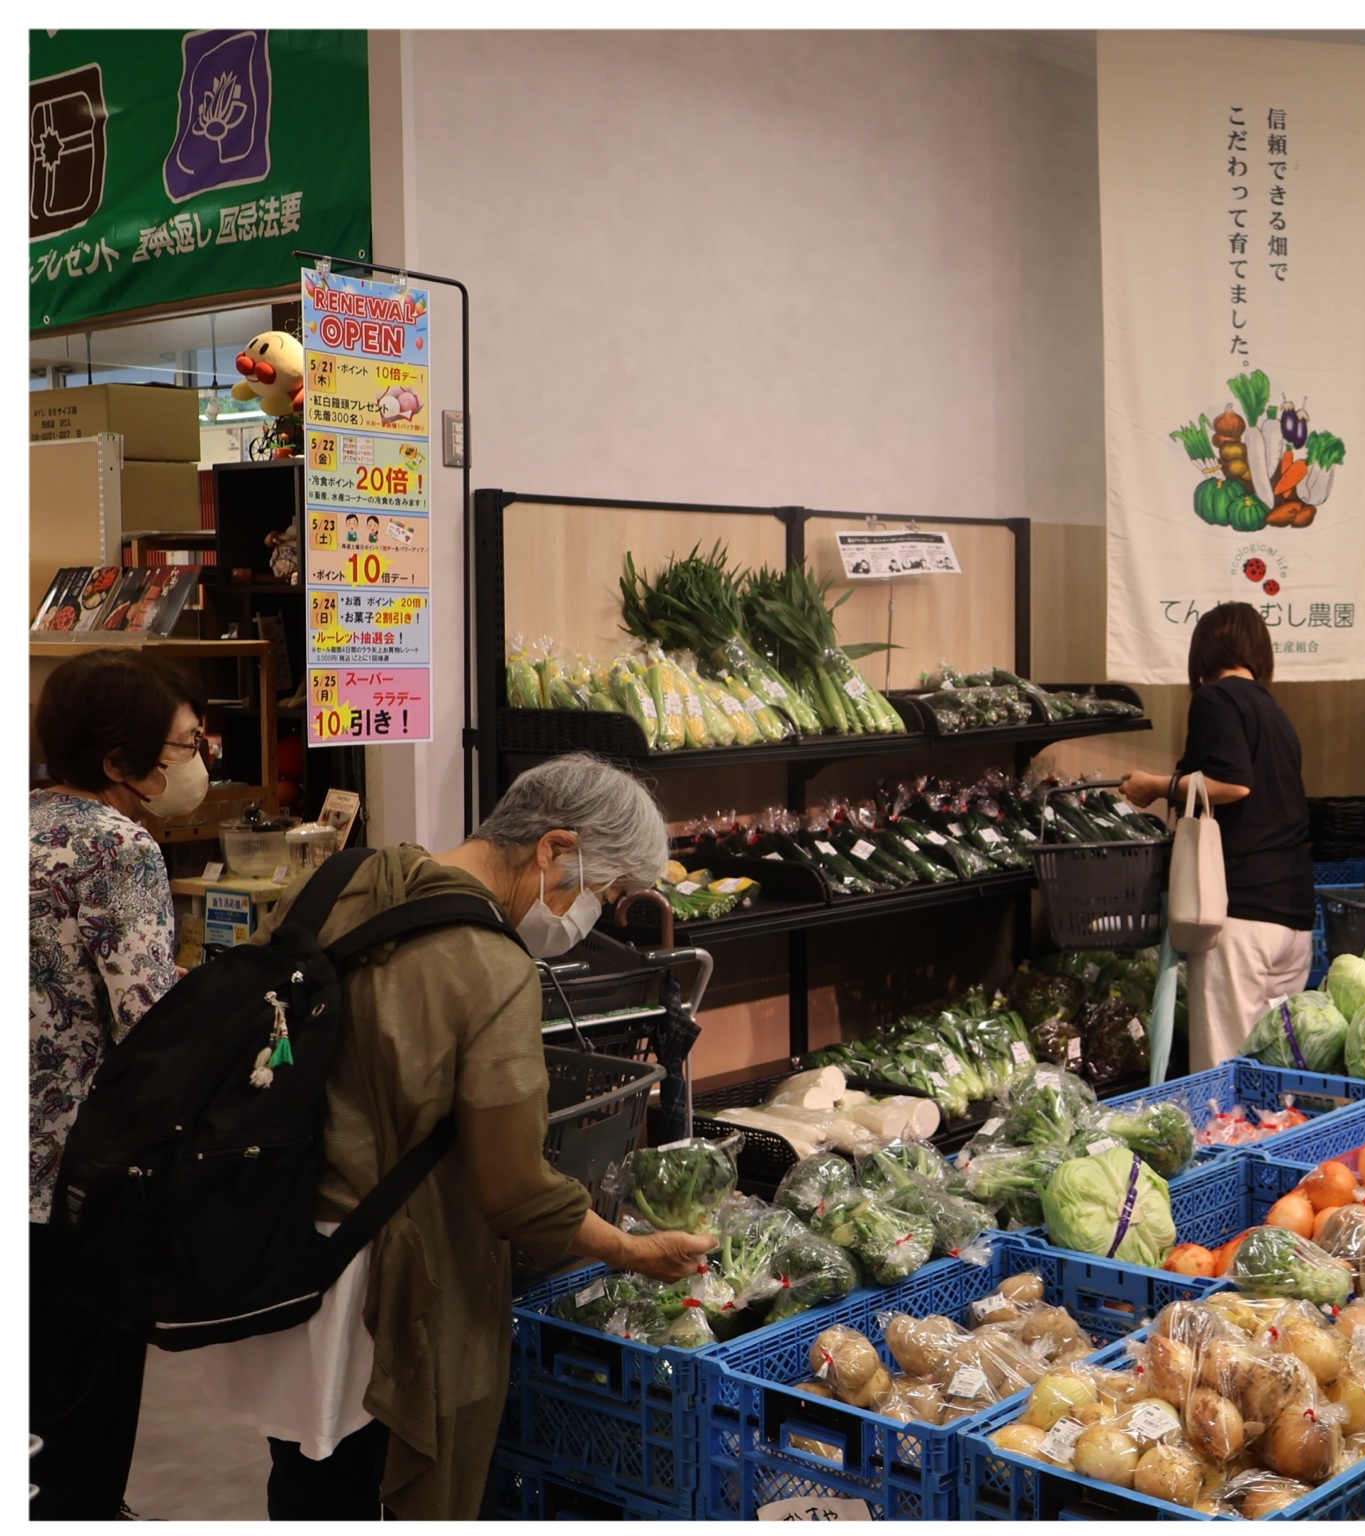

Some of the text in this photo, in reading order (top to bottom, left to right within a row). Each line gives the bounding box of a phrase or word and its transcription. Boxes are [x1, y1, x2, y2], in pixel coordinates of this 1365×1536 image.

[1266, 108, 1289, 283] 信頼できる畑で
[1227, 107, 1251, 369] こだわって育てました。
[313, 288, 417, 325] RENEWAL
[320, 315, 404, 357] OPEN
[310, 360, 334, 372] 5/21
[311, 438, 334, 451] 5/22
[312, 518, 335, 531] 5/23
[1231, 541, 1289, 579] ecological life
[313, 598, 336, 610] 5/24
[313, 672, 394, 688] 5/25 スーパー
[373, 692, 422, 706] ララデー
